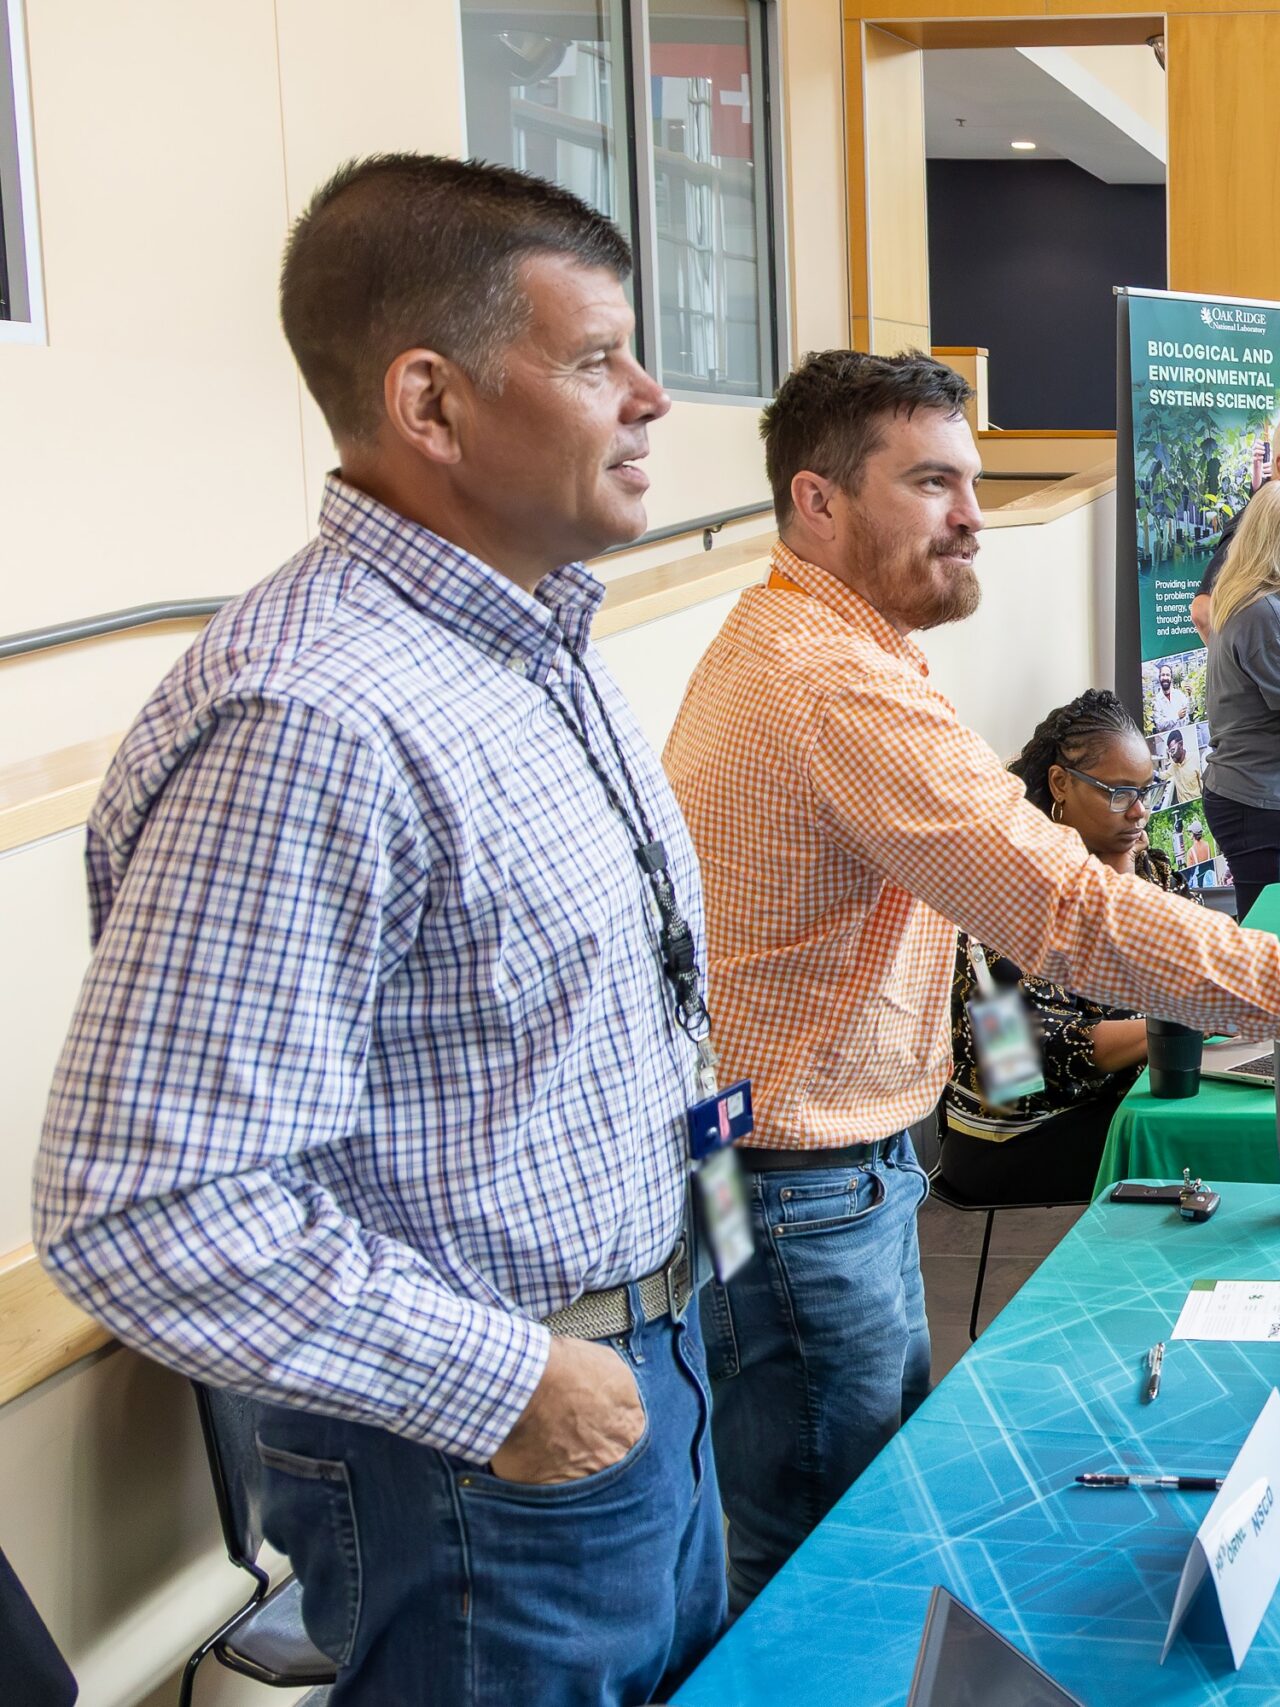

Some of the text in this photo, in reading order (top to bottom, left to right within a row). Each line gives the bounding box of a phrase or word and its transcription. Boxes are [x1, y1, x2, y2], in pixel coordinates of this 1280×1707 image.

[1211, 307, 1266, 325] OAK RIDGE
[1213, 321, 1266, 336] National Laboratory
[1147, 340, 1274, 364] BIOLOGICAL AND
[1149, 365, 1275, 387] ENVIRONMENTAL
[1149, 388, 1275, 410] SYSTEMS SCIENCE
[1155, 579, 1186, 590] Providing
[1156, 591, 1196, 602] to problems
[1156, 604, 1162, 612] in
[1156, 614, 1182, 625] through
[1156, 627, 1170, 636] and
